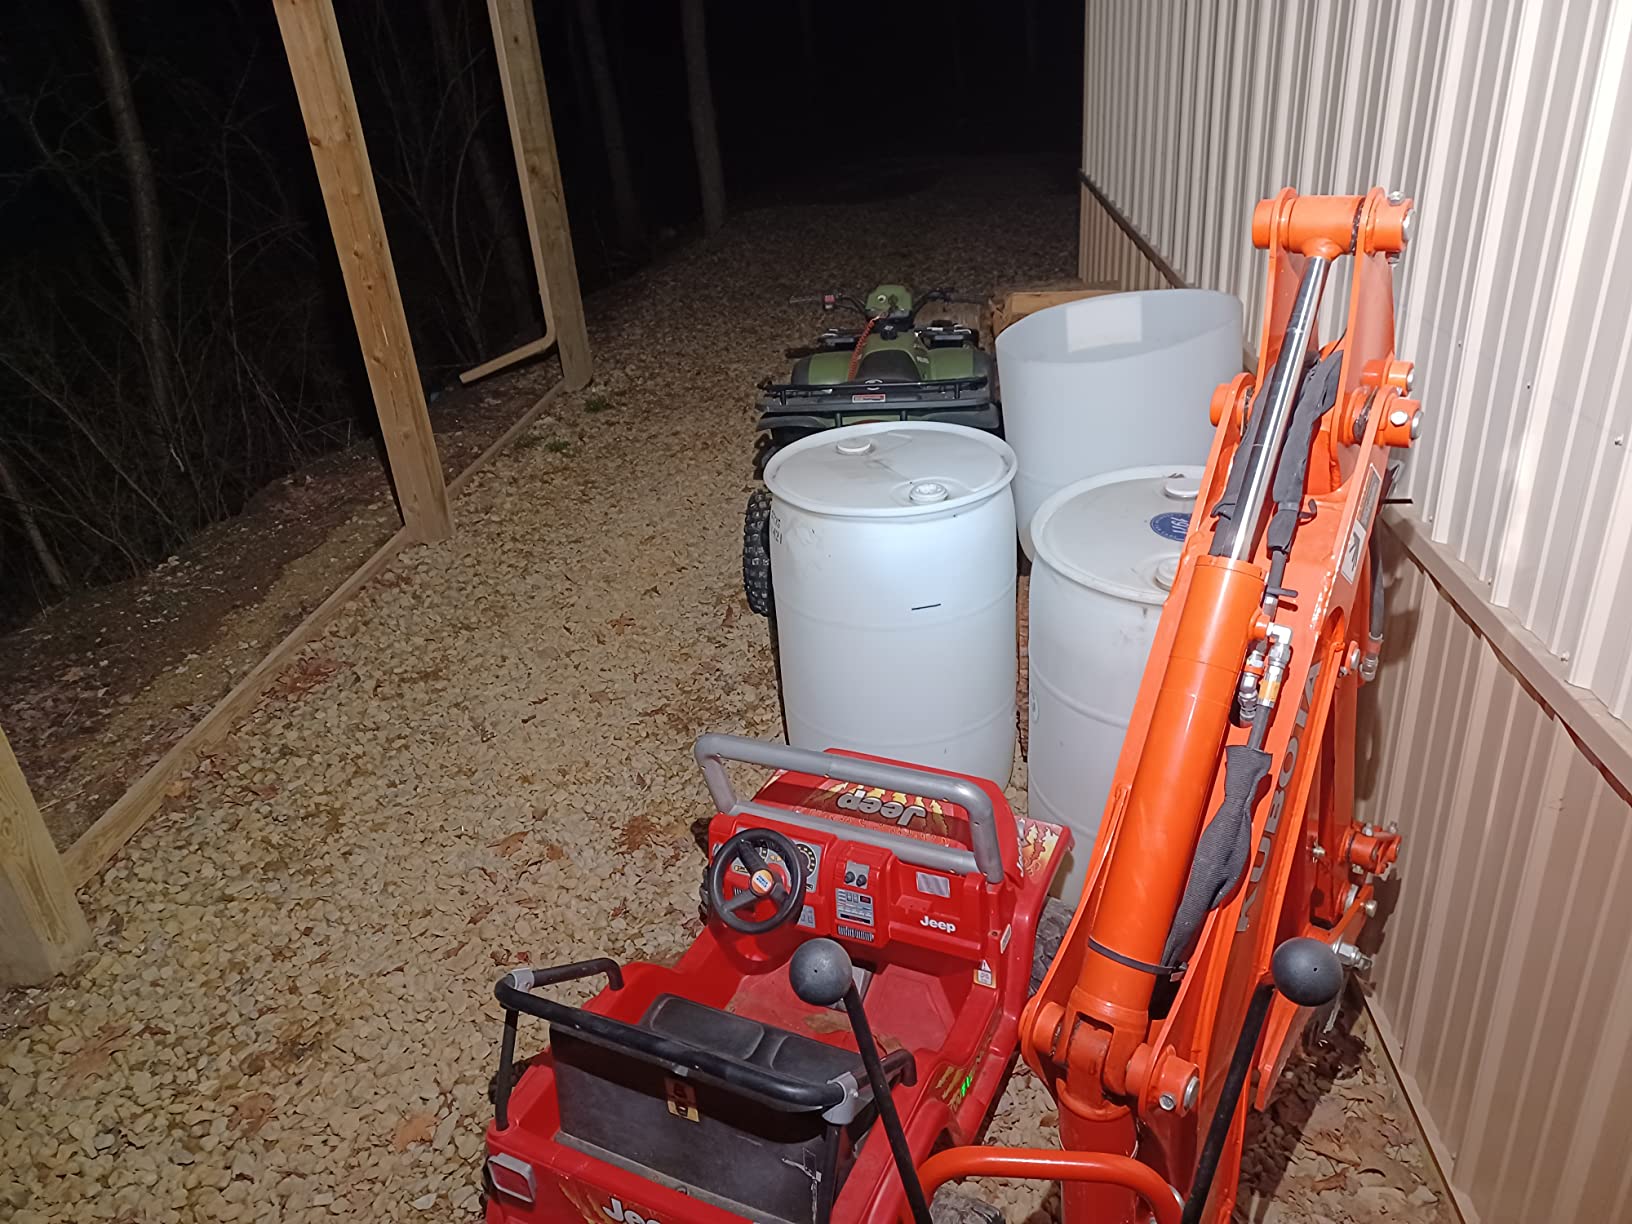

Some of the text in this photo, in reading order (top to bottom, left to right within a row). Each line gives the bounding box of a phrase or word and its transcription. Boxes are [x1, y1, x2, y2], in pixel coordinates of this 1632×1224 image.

[837, 789, 927, 826] Jeep
[920, 915, 956, 933] Jeep
[602, 1197, 661, 1224] Je
